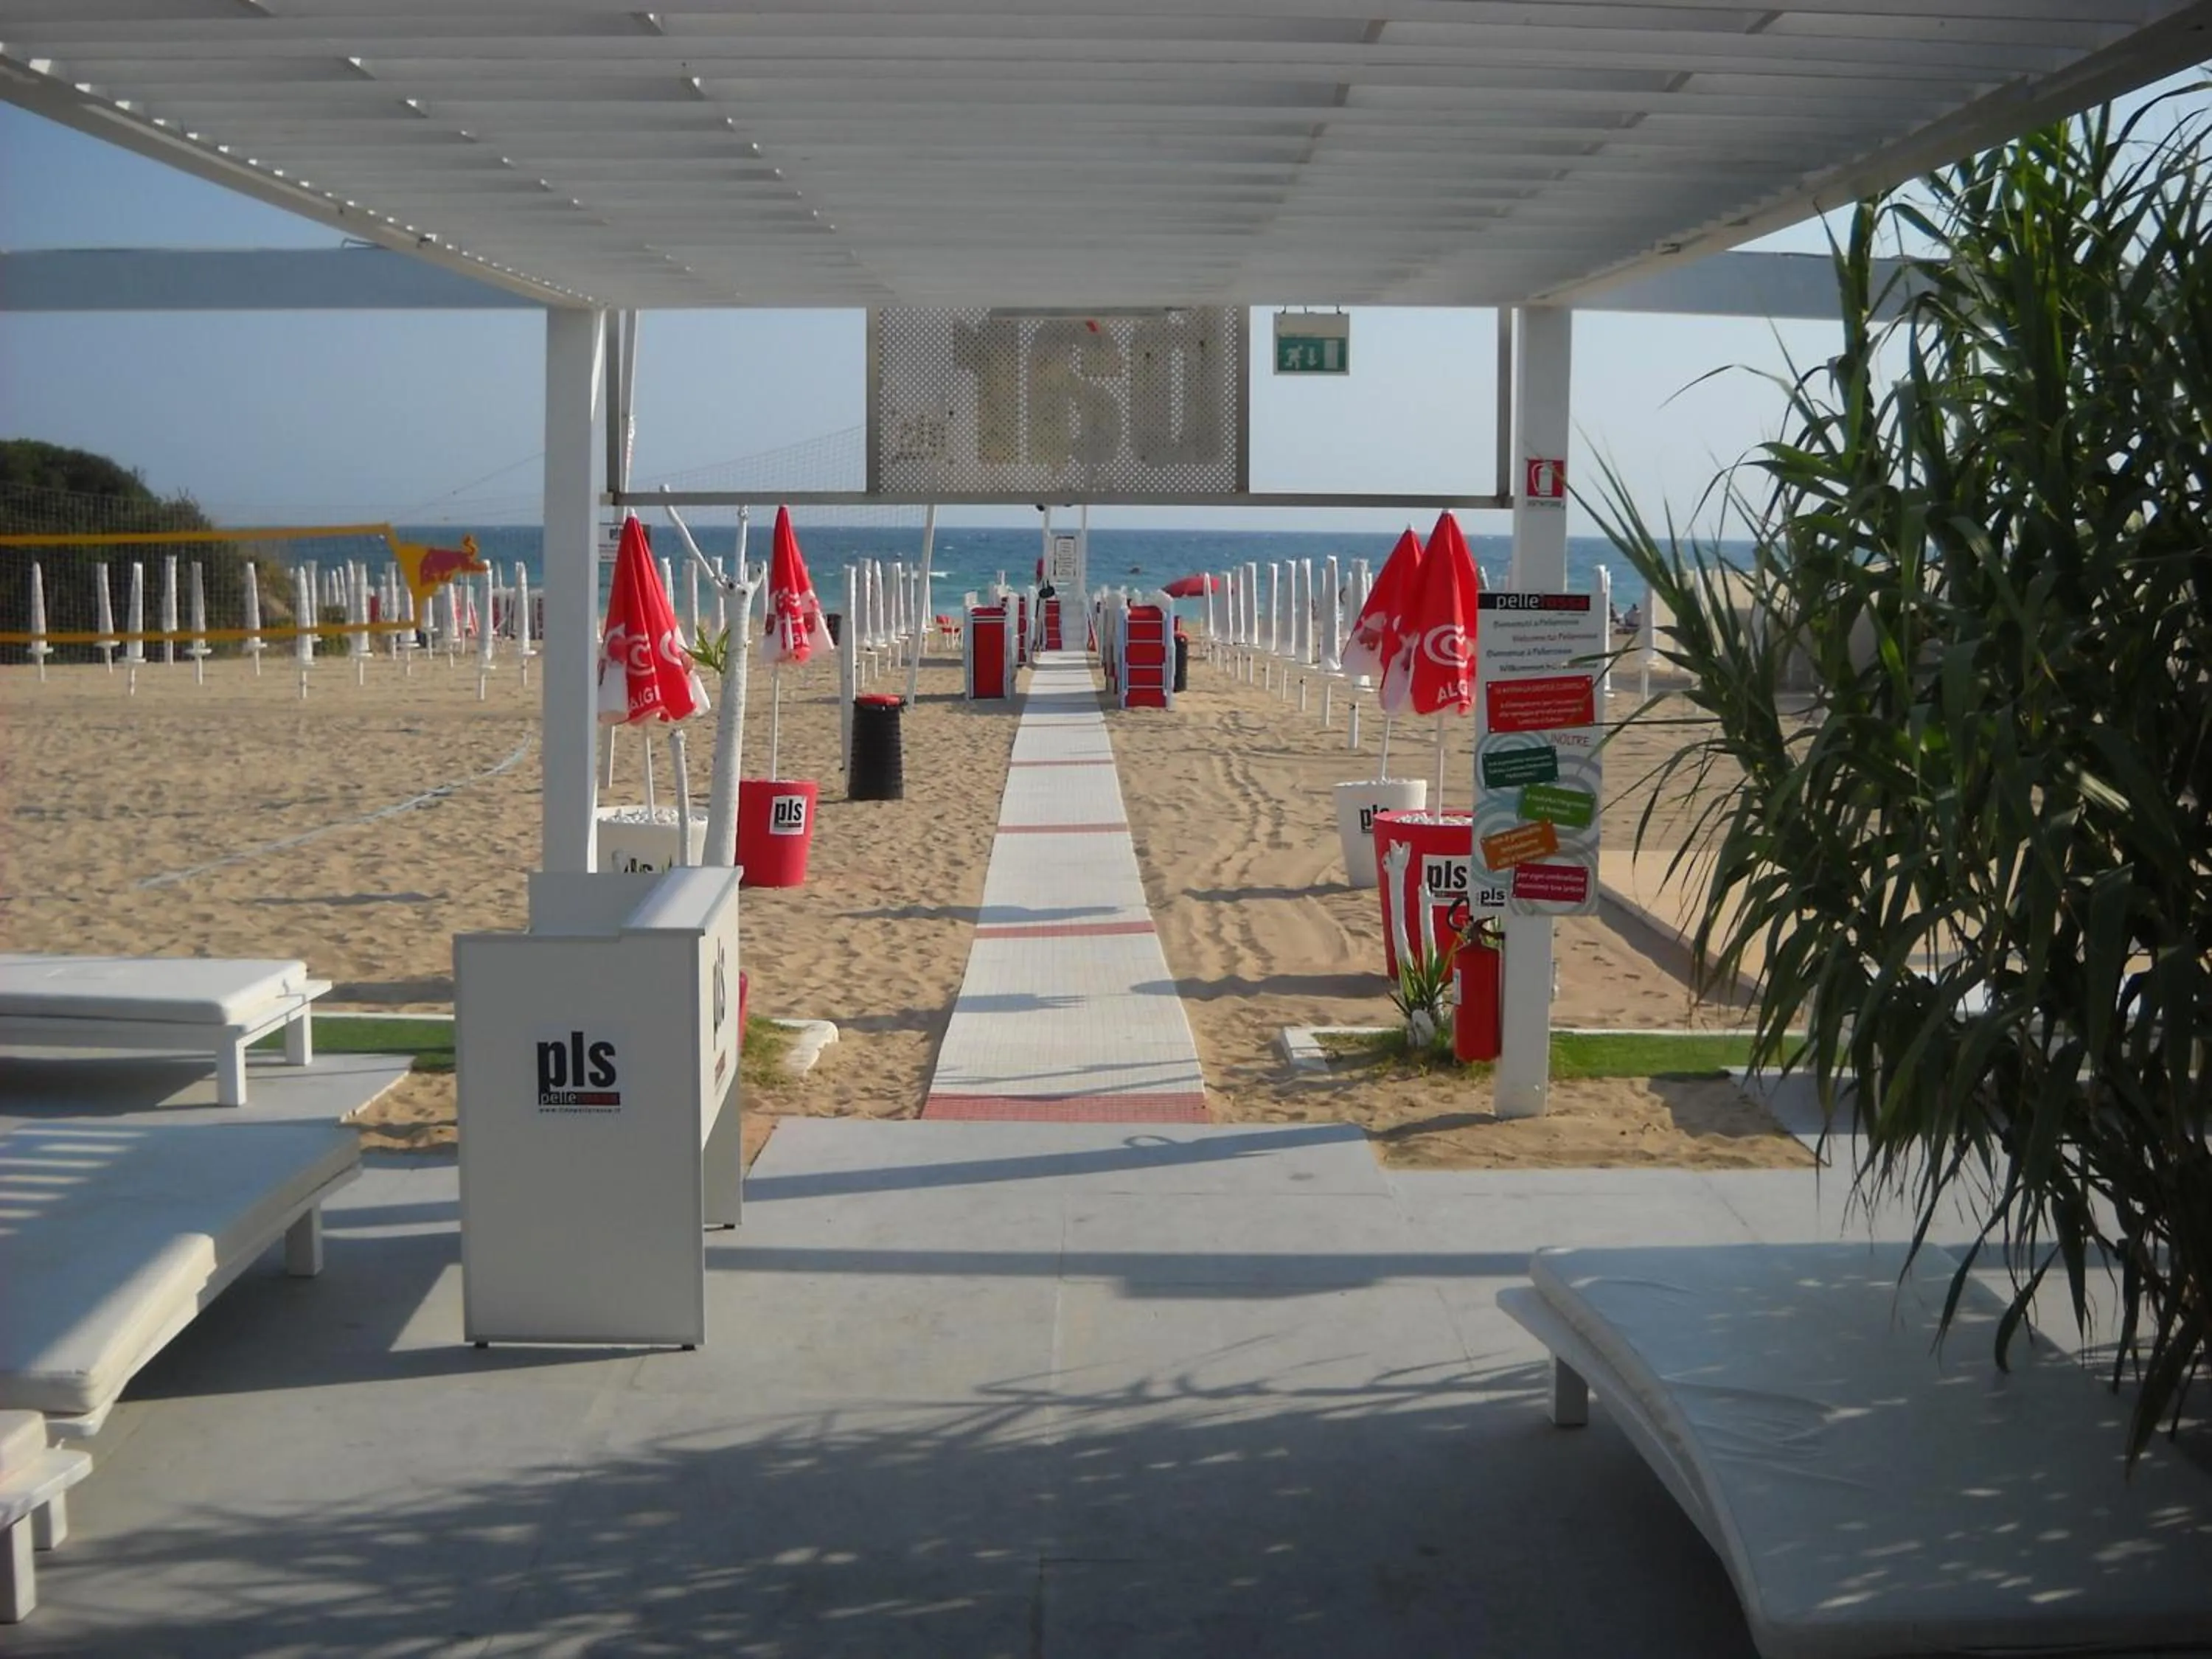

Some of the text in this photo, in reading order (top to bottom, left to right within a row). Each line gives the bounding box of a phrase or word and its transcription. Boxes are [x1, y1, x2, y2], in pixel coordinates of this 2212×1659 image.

[774, 799, 802, 827] pls
[1427, 861, 1467, 894] pls
[1481, 888, 1505, 905] pls
[537, 1031, 616, 1104] pls
